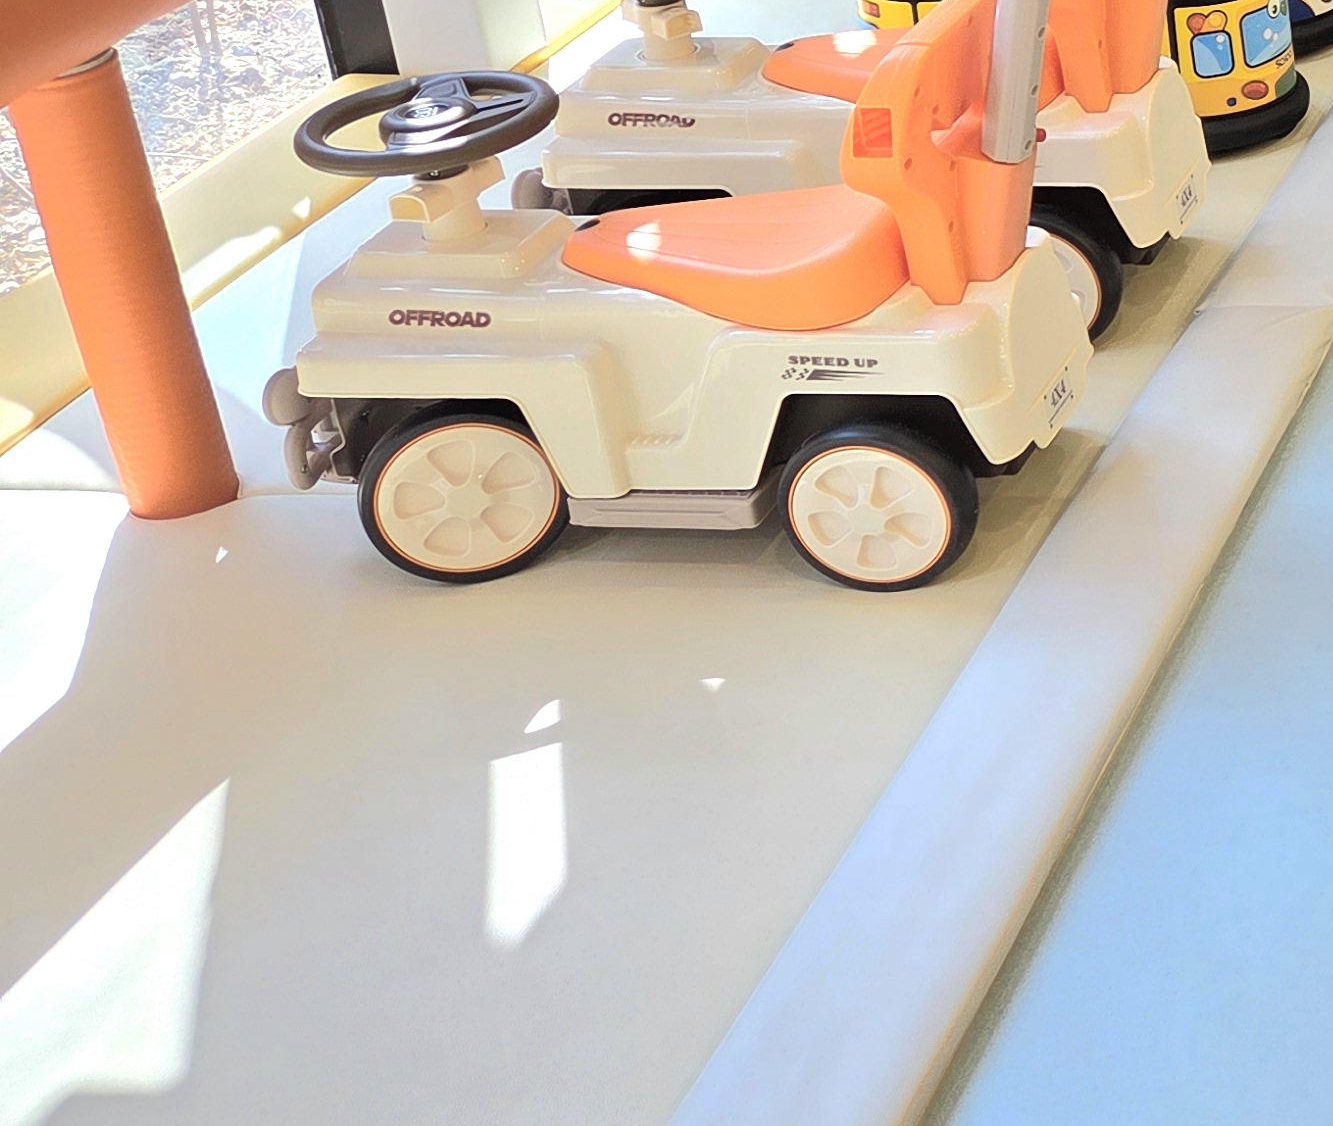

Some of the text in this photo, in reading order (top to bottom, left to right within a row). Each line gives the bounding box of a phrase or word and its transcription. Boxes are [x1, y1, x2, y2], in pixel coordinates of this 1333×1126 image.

[607, 112, 696, 128] OFFROAD
[388, 309, 492, 328] OFFROAD
[788, 355, 879, 368] SPEED UP
